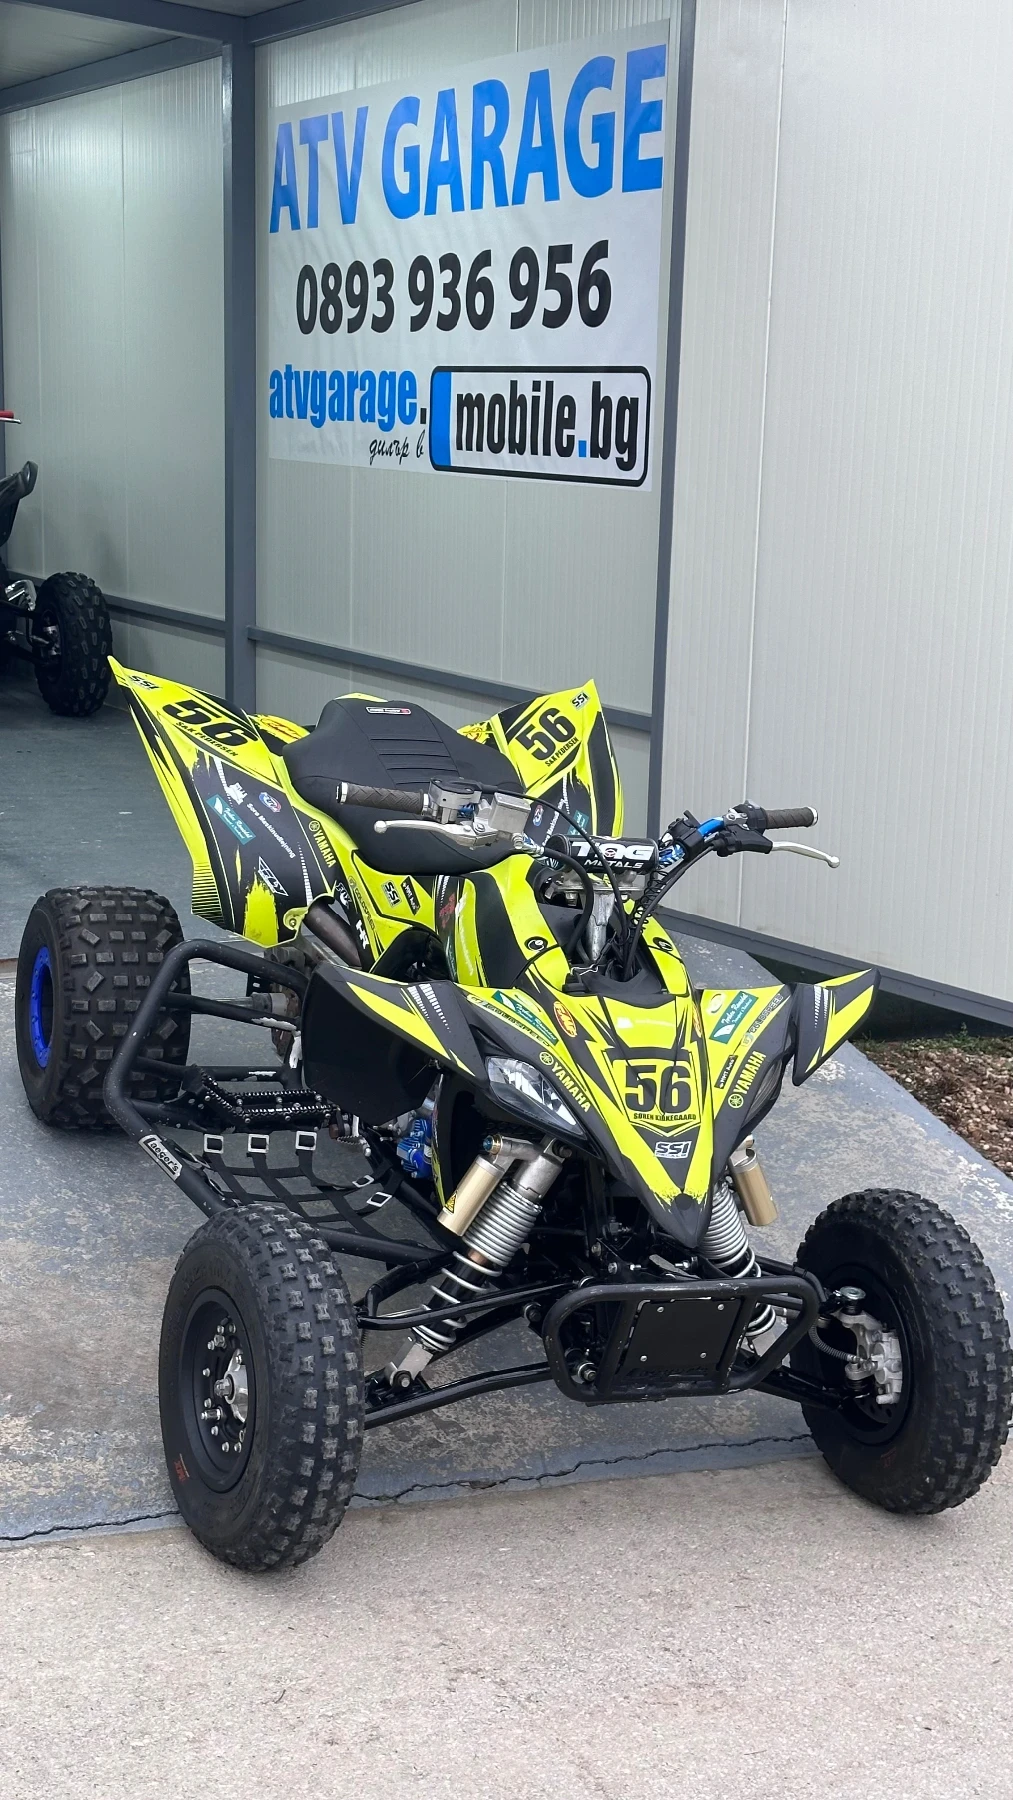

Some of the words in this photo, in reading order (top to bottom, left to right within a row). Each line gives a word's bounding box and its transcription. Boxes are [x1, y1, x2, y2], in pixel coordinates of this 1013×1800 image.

[269, 106, 369, 234] ATV
[382, 44, 666, 220] GARAGE
[297, 258, 395, 334] 0893
[408, 250, 494, 332] 936
[509, 239, 612, 329] 956
[456, 380, 639, 471] mobile.bg
[130, 675, 160, 690] SSI
[571, 692, 589, 707] SSI
[162, 699, 259, 747] 56
[514, 707, 576, 761] 56
[556, 737, 580, 760] PEDERSEN
[312, 829, 338, 868] YAMAHA
[384, 881, 401, 905] SSI
[550, 1062, 592, 1113] YAMAHA
[625, 1065, 692, 1114] 56
[734, 1050, 767, 1095] YAMAHA
[656, 1143, 690, 1154] SSI
